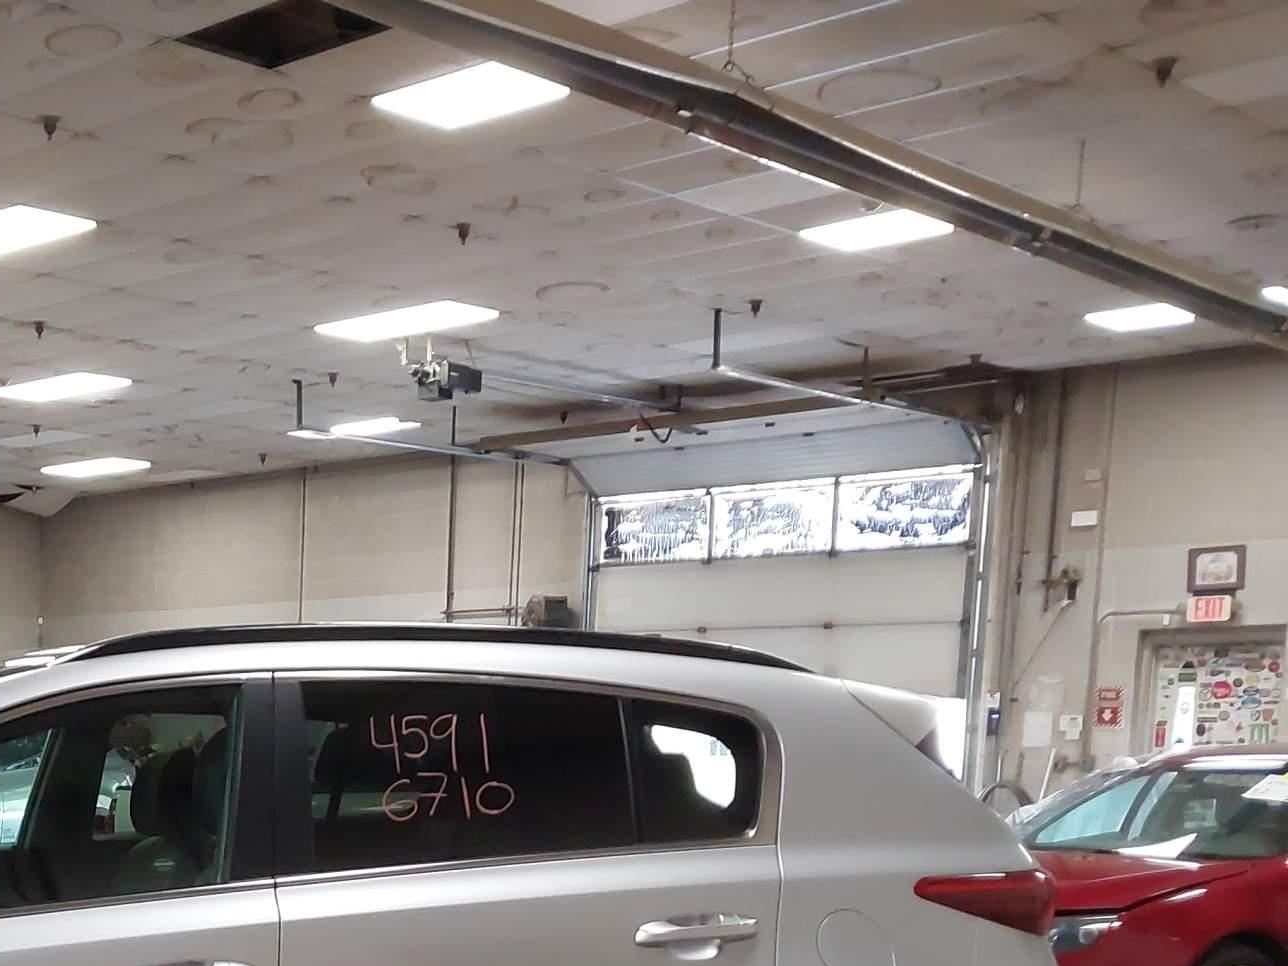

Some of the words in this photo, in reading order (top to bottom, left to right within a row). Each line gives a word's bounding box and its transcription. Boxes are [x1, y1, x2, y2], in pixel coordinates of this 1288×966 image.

[1194, 597, 1225, 620] EXIT
[369, 712, 490, 775] 4591
[381, 772, 515, 822] 6710
